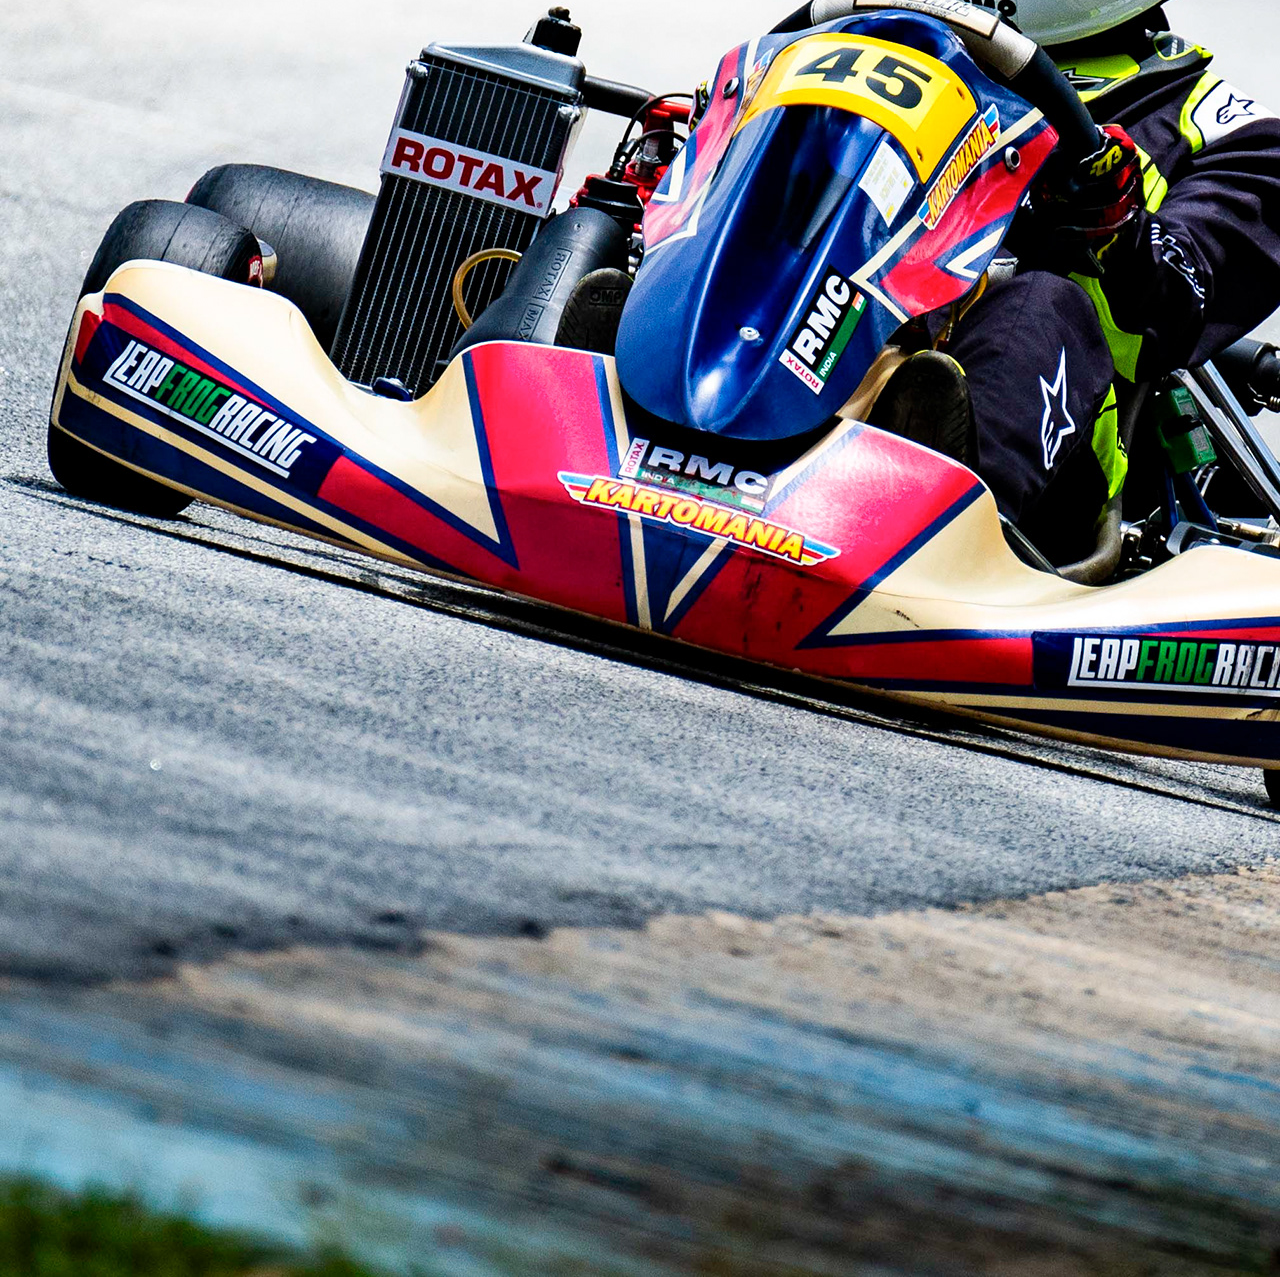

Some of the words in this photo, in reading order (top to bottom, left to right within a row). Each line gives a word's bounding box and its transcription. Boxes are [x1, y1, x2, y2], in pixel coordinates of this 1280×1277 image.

[795, 47, 933, 110] 45
[391, 136, 543, 208] ROTAX
[926, 119, 995, 226] KARTOMANIA
[538, 252, 567, 297] ROTAX
[518, 309, 539, 341] MAX
[792, 275, 850, 365] RMC
[785, 355, 820, 389] ROTAX
[818, 351, 837, 378] INDIA
[102, 339, 317, 472] LEAPFROGRACING
[624, 441, 645, 474] ROTAX
[641, 470, 675, 485] INDIA
[647, 445, 769, 495] RMC
[585, 478, 808, 562] KARTOMANIA
